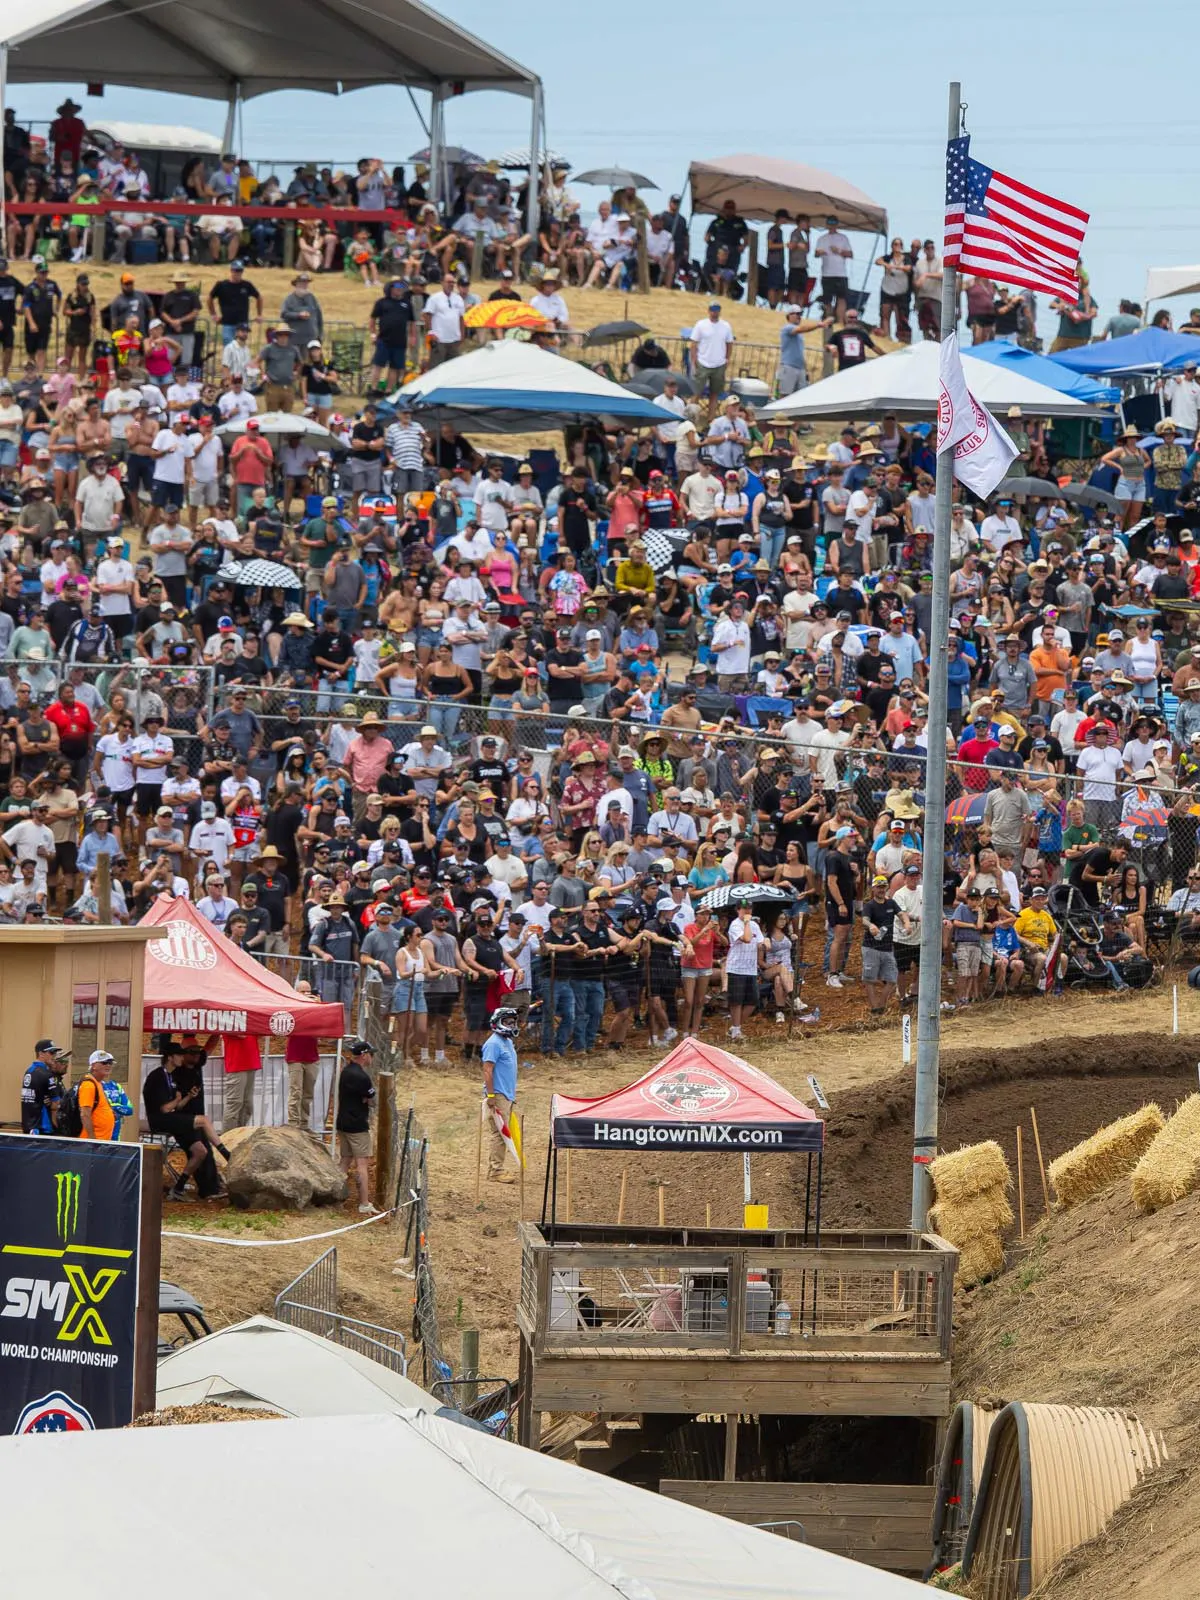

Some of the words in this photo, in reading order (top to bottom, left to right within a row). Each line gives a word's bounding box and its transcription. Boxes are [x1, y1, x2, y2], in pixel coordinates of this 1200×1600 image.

[152, 1007, 248, 1033] HANGTOWN
[593, 1123, 783, 1146] HangtownMX.com
[1, 1264, 121, 1346] SMX
[1, 1342, 39, 1360] WORLD
[40, 1346, 119, 1369] CHAMPIONSHIP
